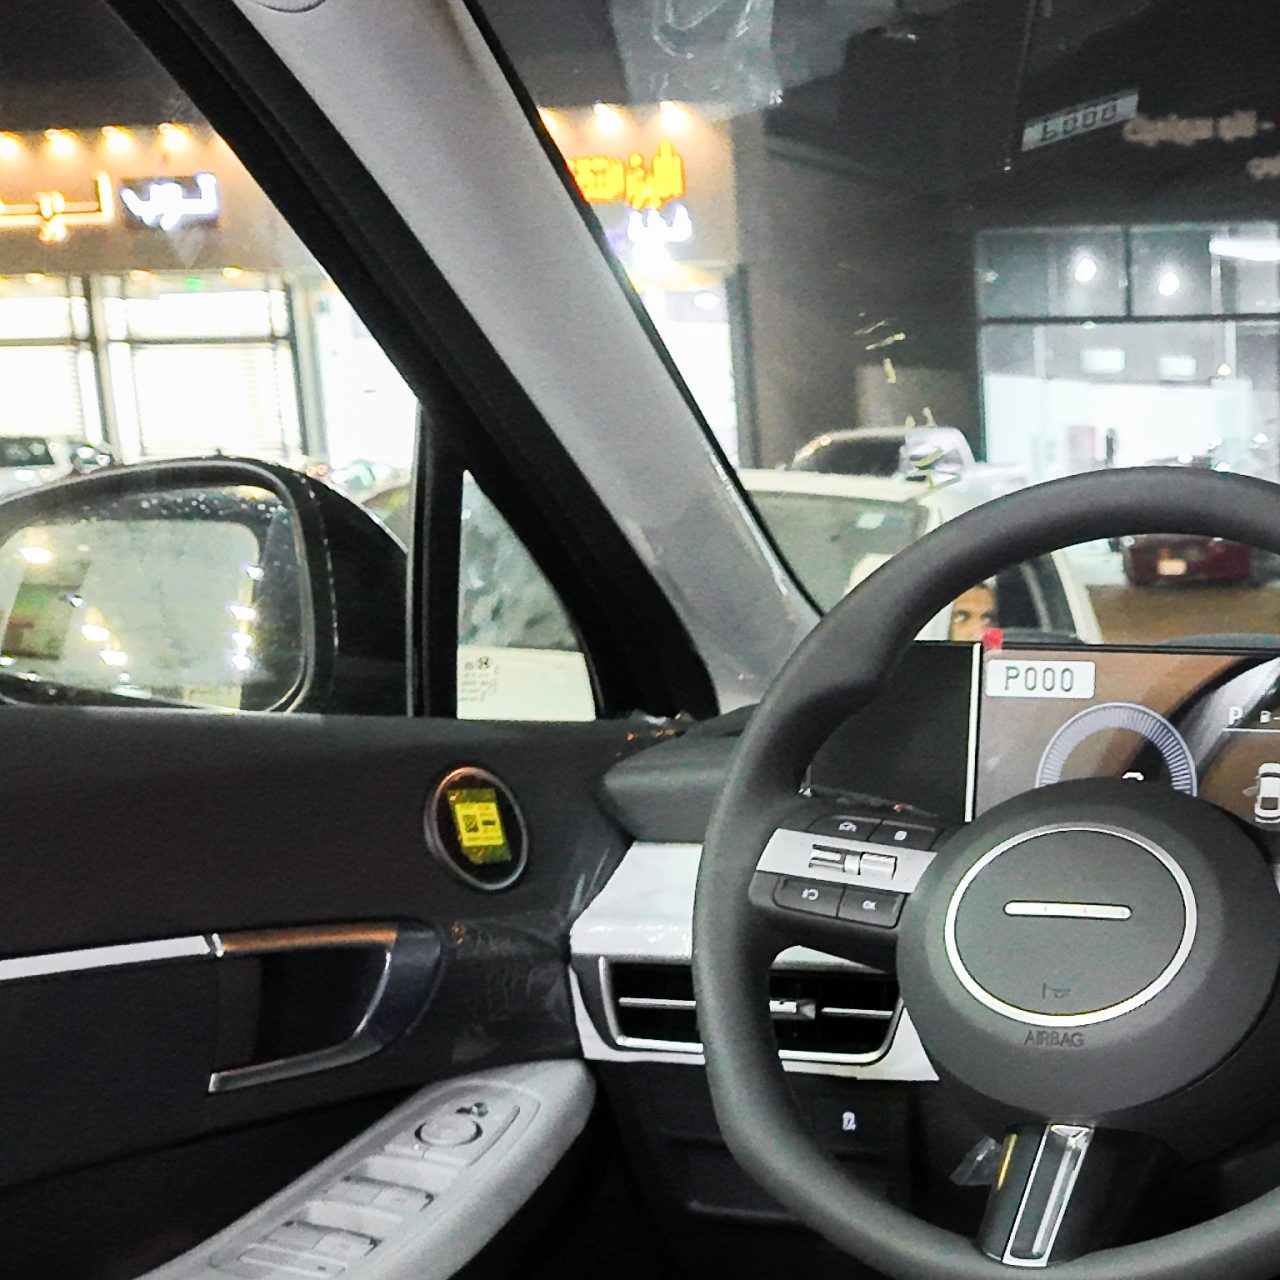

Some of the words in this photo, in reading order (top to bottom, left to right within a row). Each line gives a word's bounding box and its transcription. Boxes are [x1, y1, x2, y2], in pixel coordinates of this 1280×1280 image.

[1004, 665, 1074, 692] P000
[1228, 706, 1244, 726] P
[1024, 1030, 1084, 1047] AIRBAG
